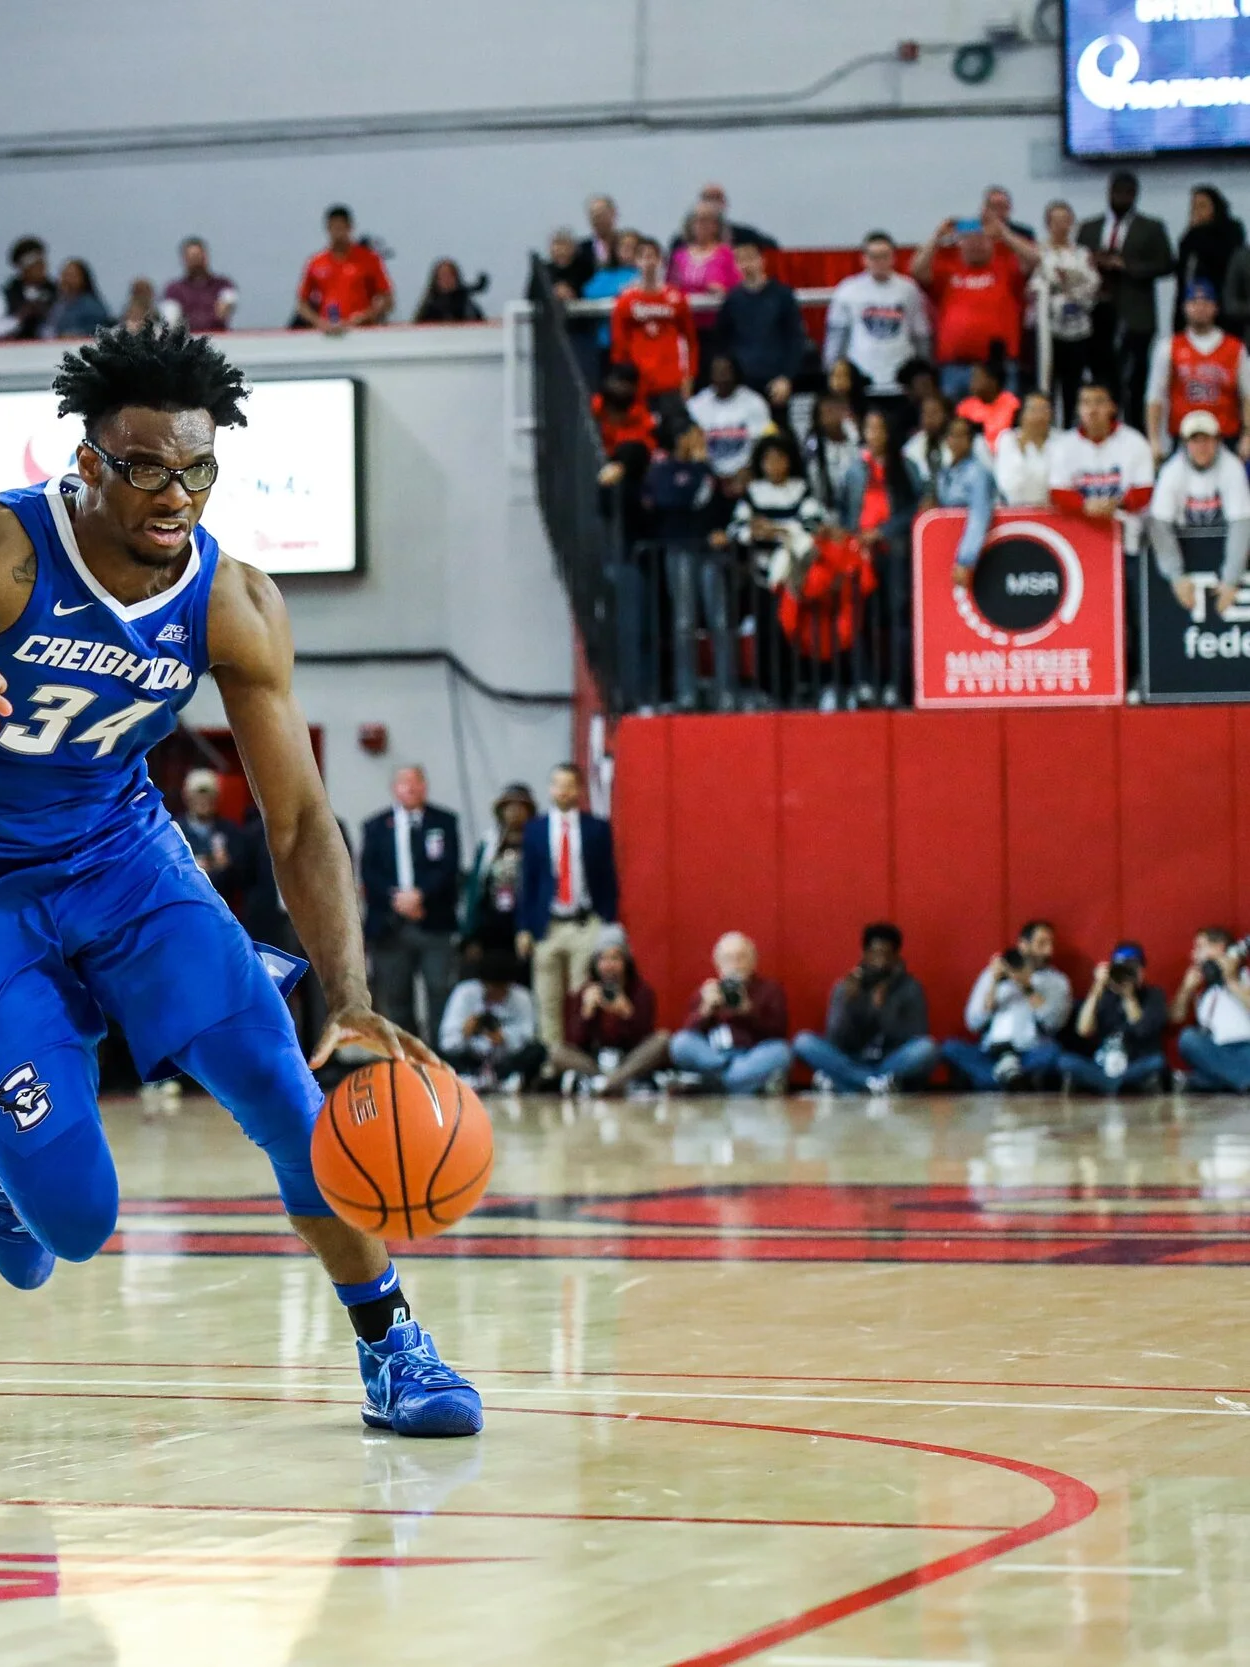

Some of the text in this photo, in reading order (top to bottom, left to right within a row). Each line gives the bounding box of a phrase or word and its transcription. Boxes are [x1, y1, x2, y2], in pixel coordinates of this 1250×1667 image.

[163, 623, 185, 633] BIG
[158, 631, 189, 641] EAST
[12, 635, 193, 690] CREIGHTON
